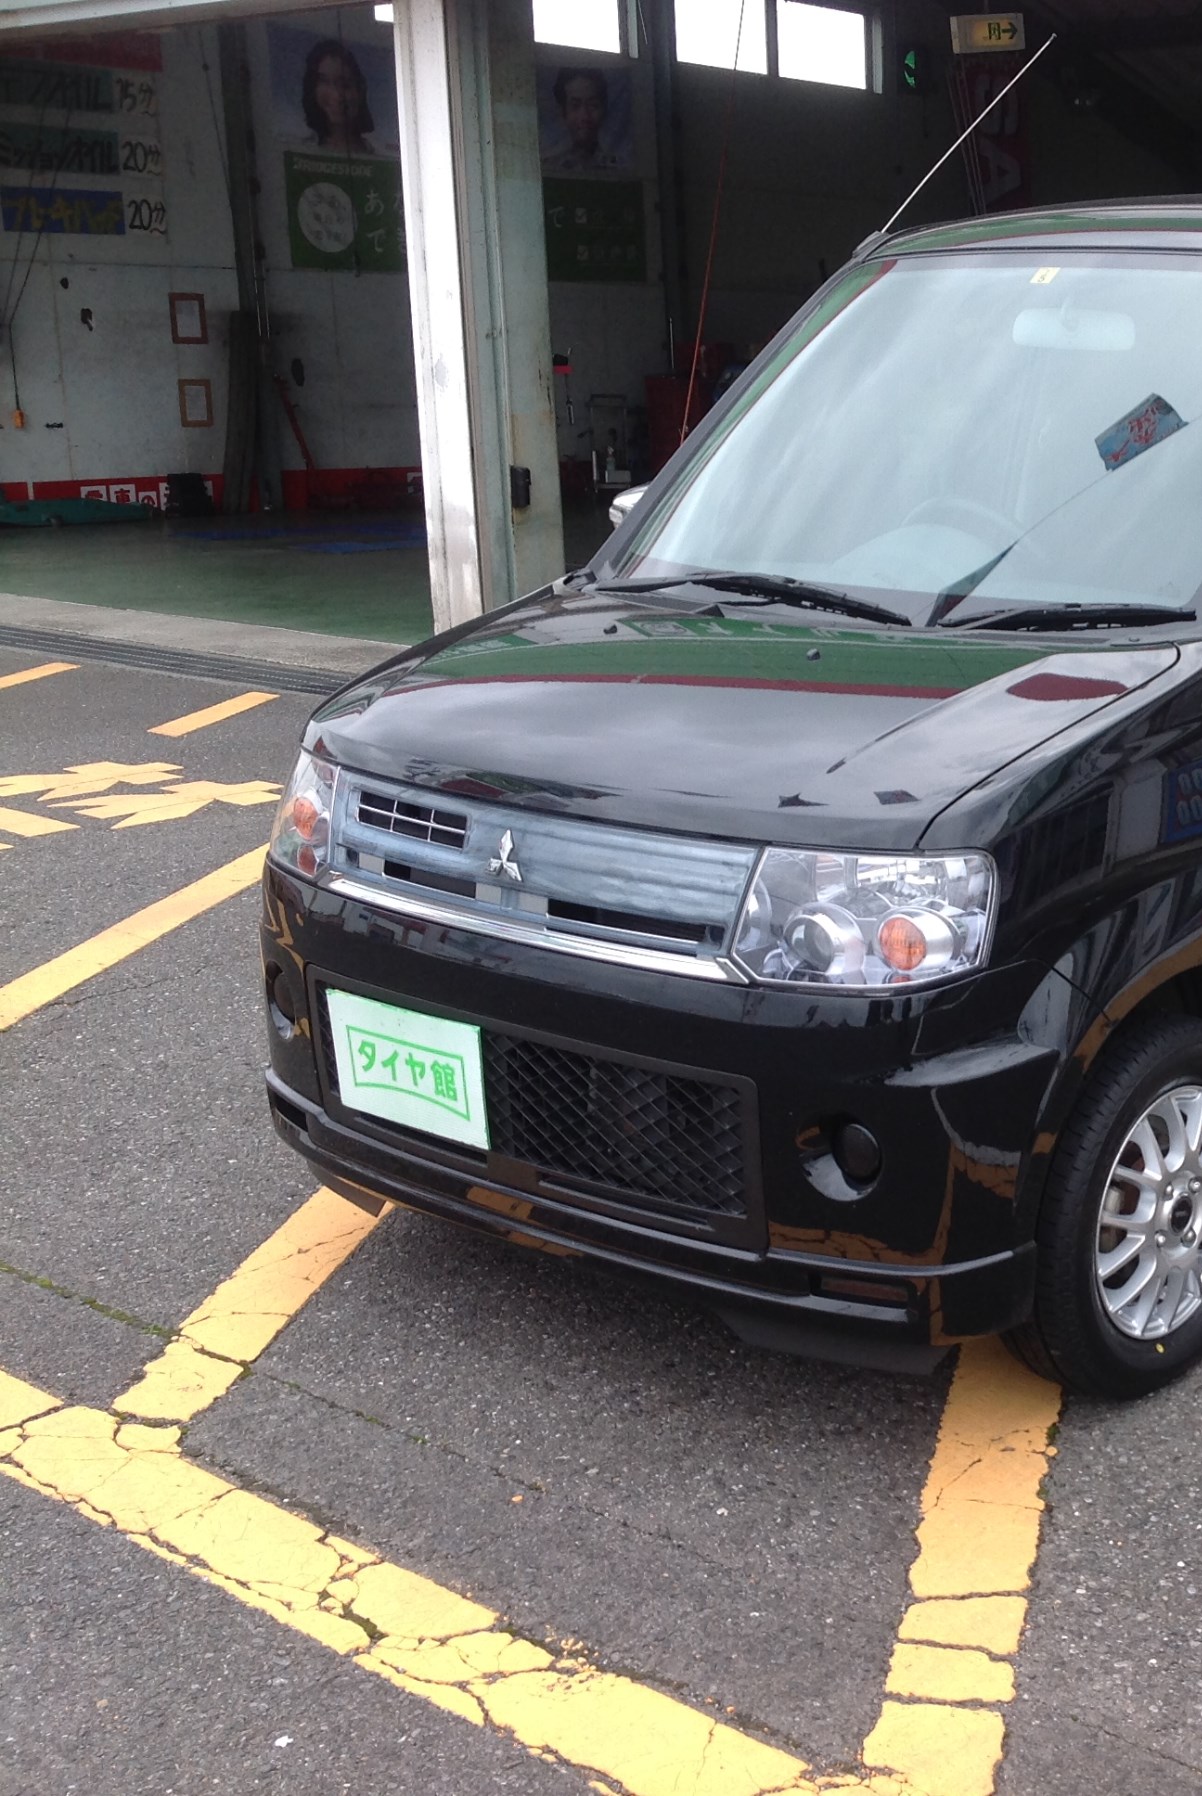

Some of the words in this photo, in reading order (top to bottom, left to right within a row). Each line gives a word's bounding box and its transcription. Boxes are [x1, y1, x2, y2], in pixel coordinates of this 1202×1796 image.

[293, 157, 374, 177] BRIDGESTONE
[358, 1039, 458, 1101] タイヤ館
